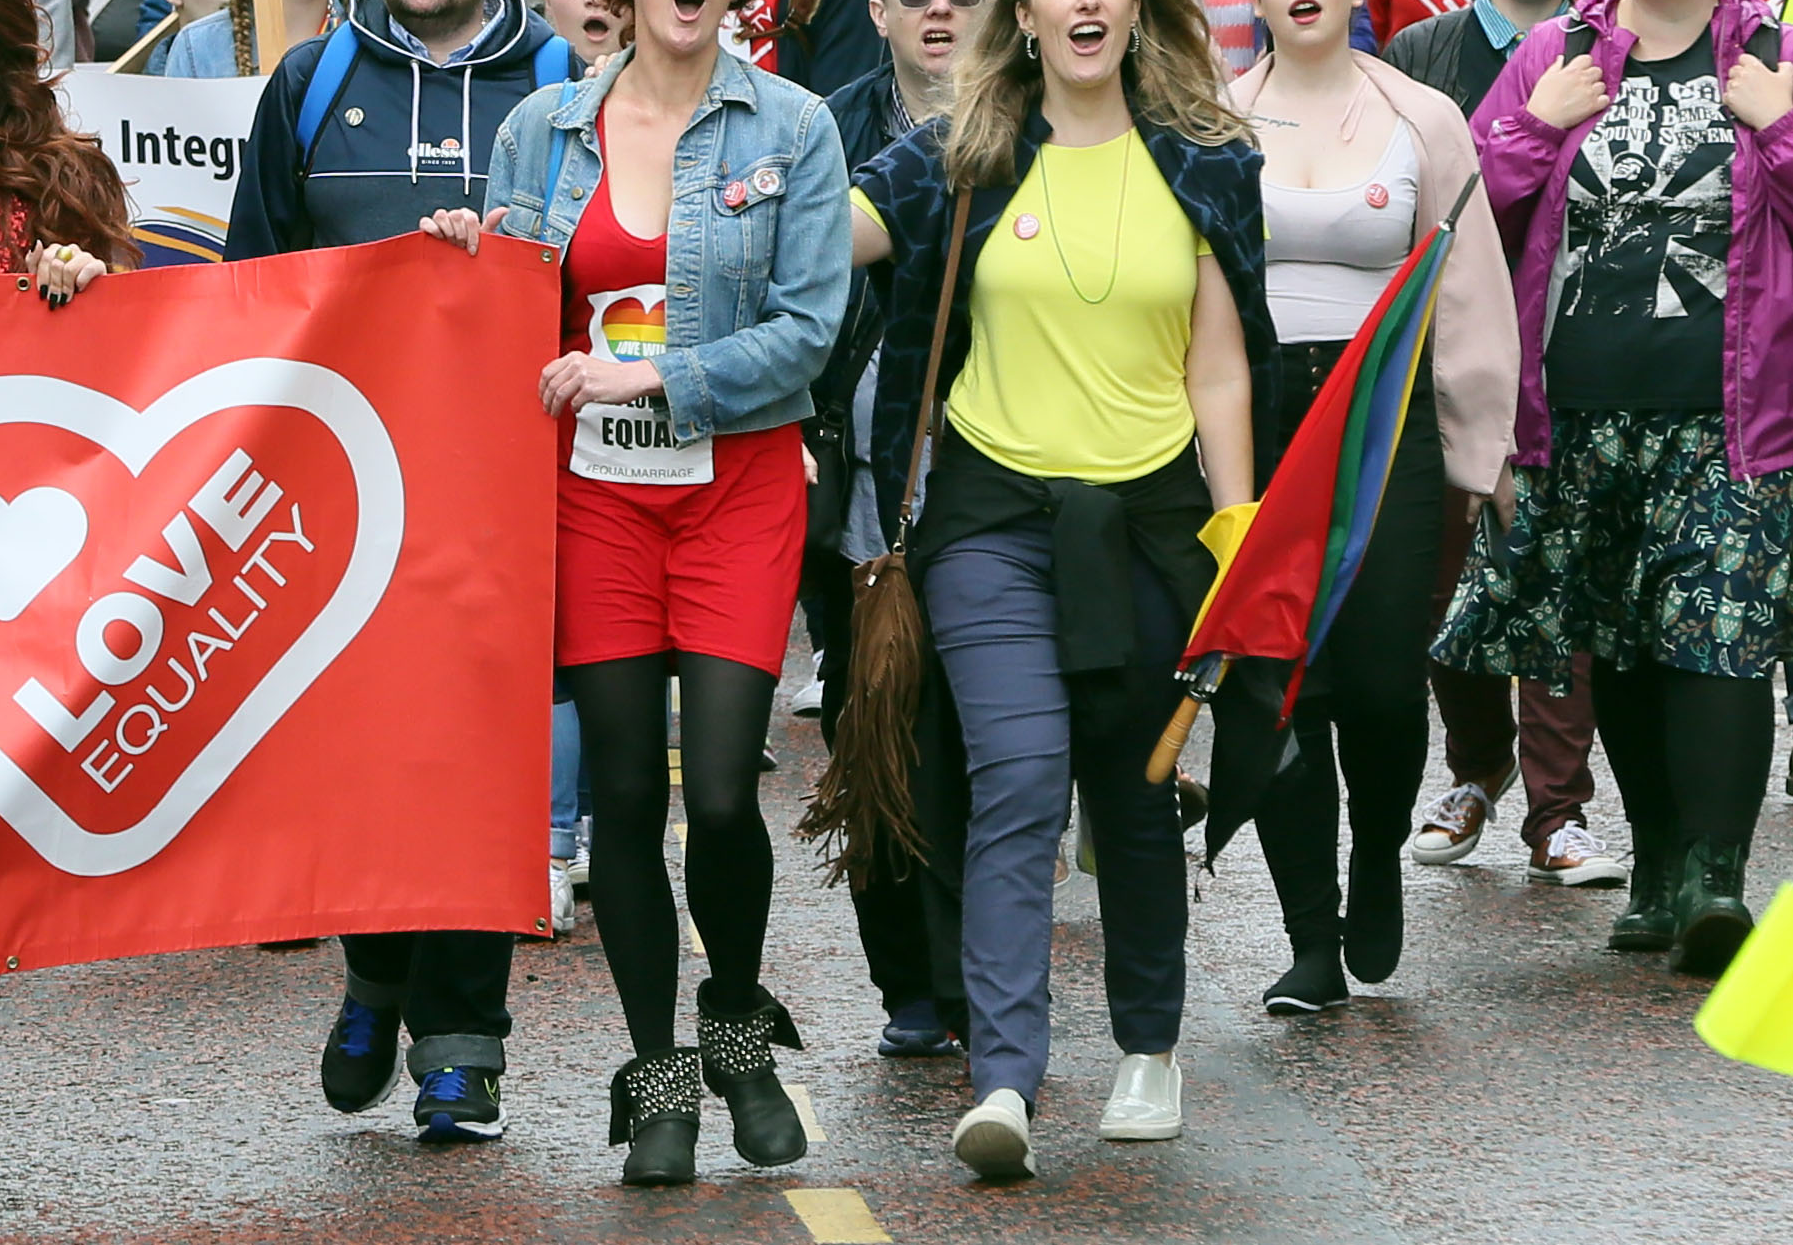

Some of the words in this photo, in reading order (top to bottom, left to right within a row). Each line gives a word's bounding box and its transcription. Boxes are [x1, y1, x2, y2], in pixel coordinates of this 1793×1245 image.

[12, 446, 285, 754] LOVE
[585, 463, 696, 479] #EQUALMARRIAGE
[79, 502, 316, 795] EQUALITY
